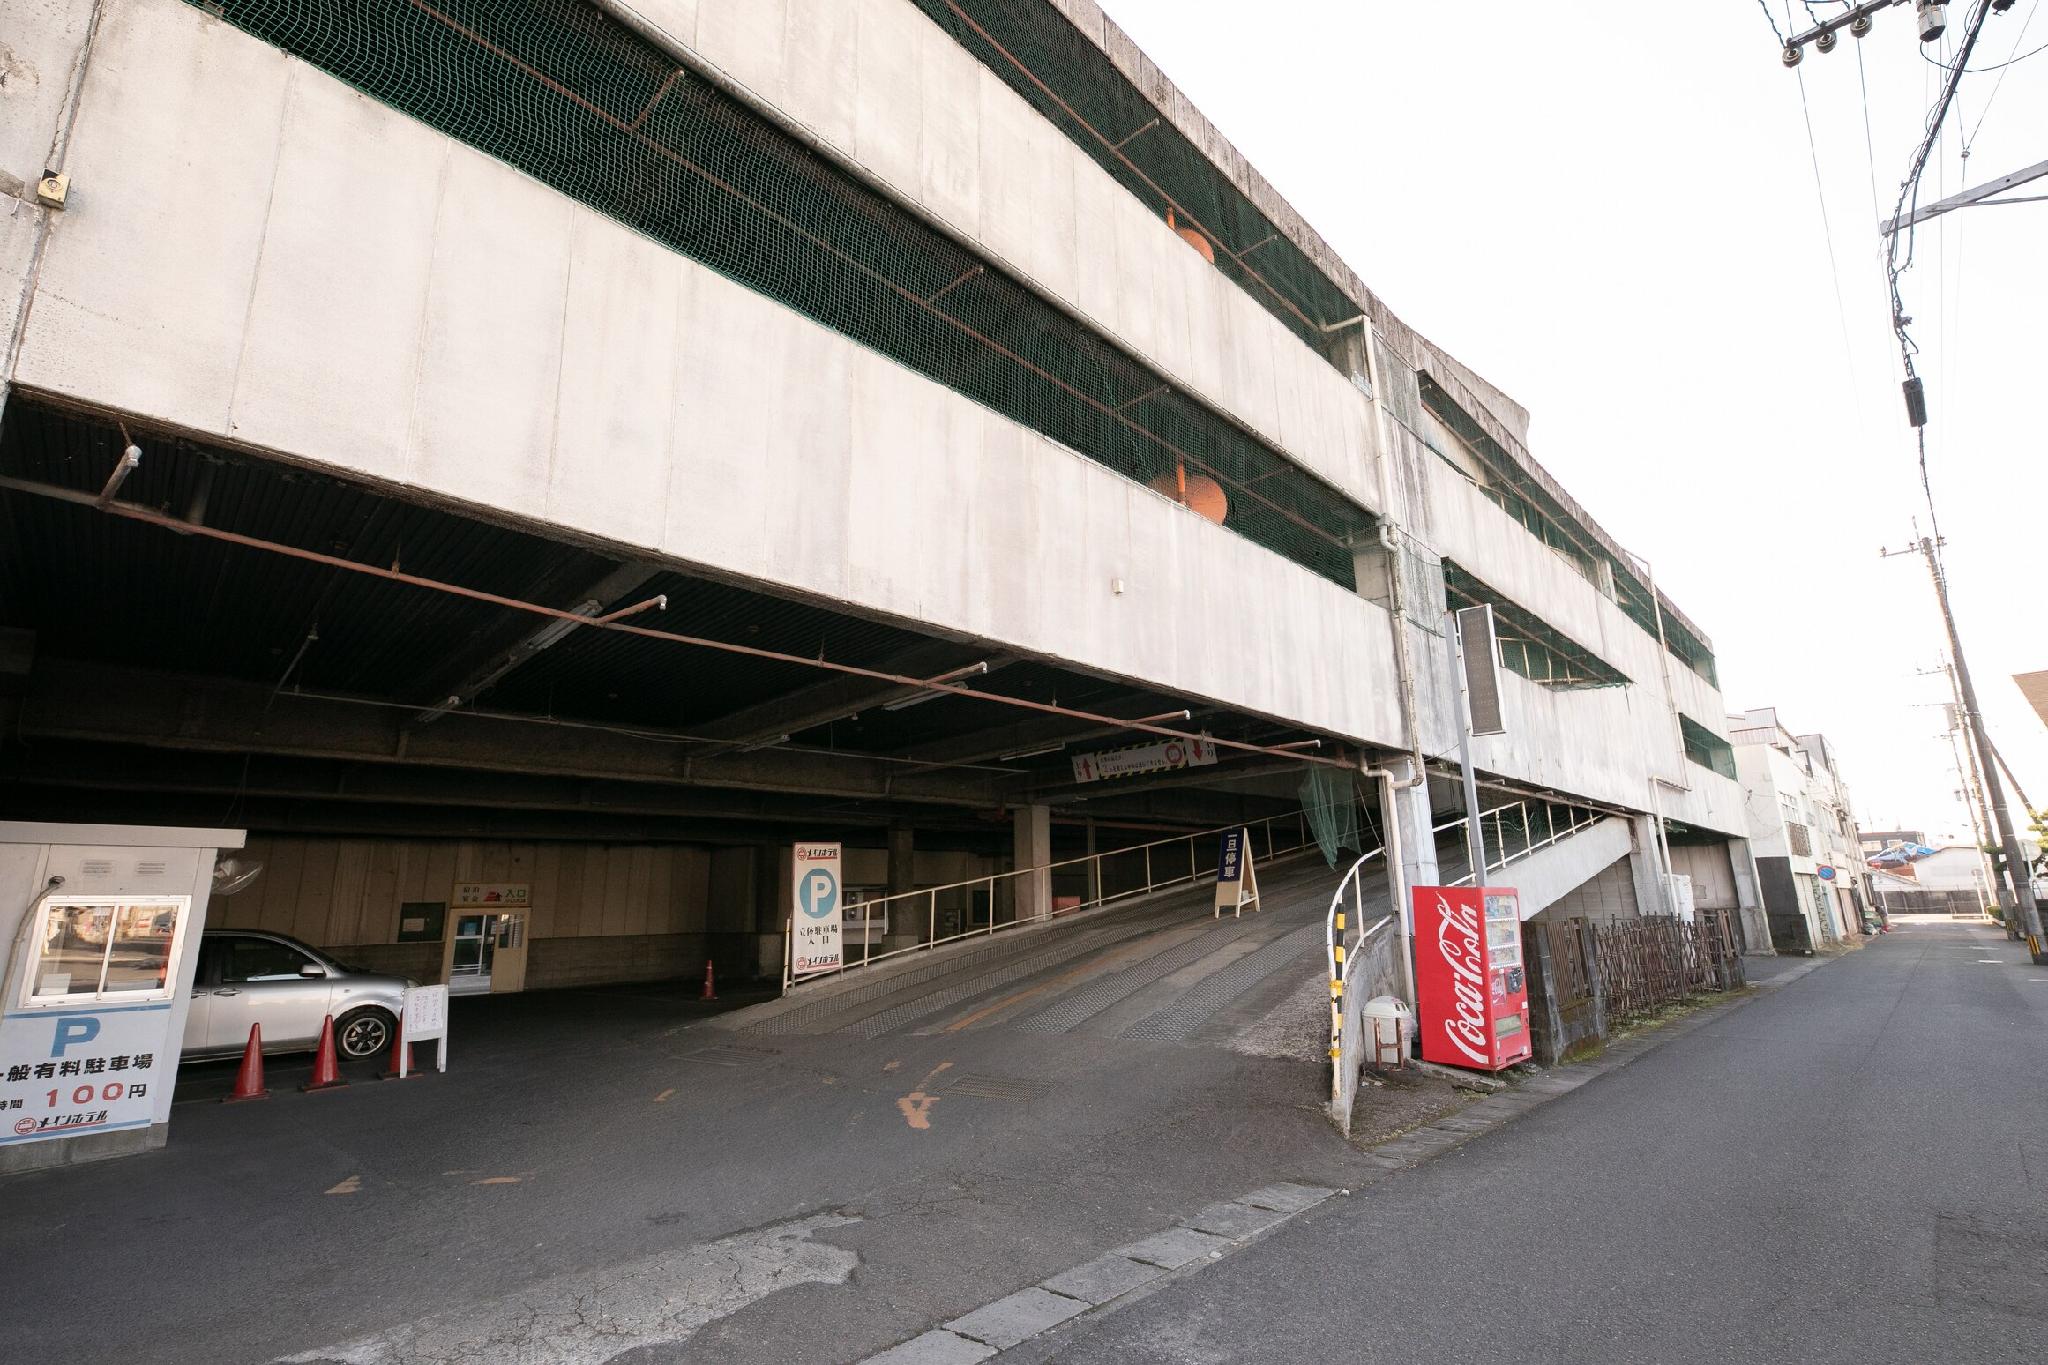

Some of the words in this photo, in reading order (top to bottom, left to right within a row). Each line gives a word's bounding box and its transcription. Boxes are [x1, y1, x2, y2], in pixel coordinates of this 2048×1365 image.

[1223, 833, 1238, 878] 一旦停車
[810, 875, 832, 913] P
[1435, 890, 1489, 1065] Coca-Cola
[50, 1017, 101, 1058] P
[0, 1053, 154, 1083] 般有料駐車場
[38, 1110, 108, 1129] メインホテル
